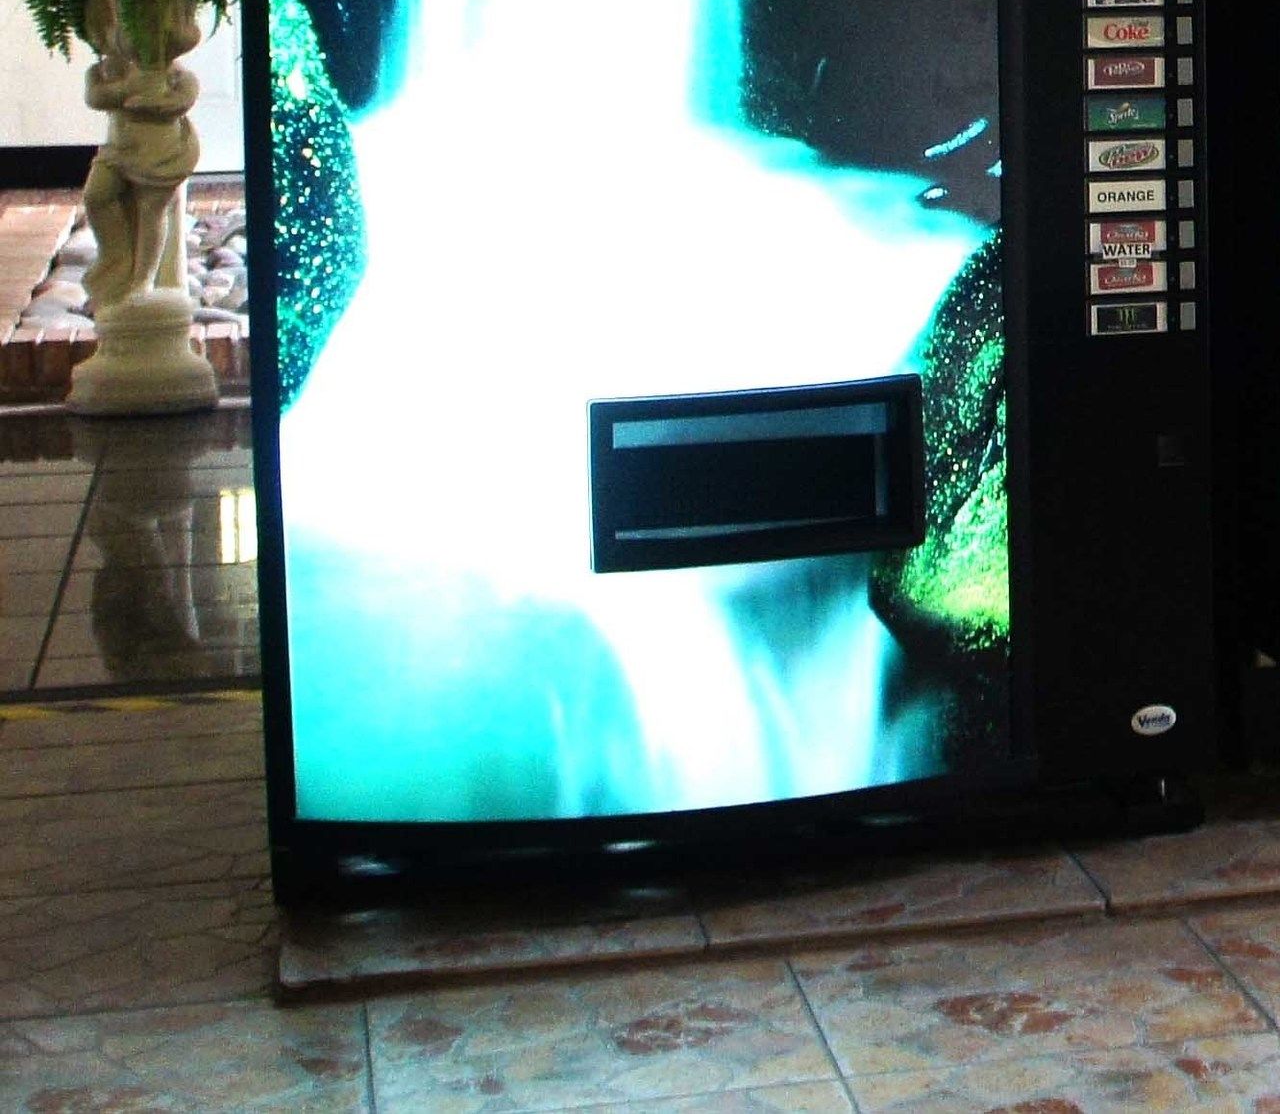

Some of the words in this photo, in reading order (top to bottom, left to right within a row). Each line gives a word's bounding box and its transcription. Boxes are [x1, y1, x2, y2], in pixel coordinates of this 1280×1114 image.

[1103, 23, 1151, 40] Coke
[1097, 190, 1155, 203] ORANGE
[1103, 243, 1151, 257] WATER
